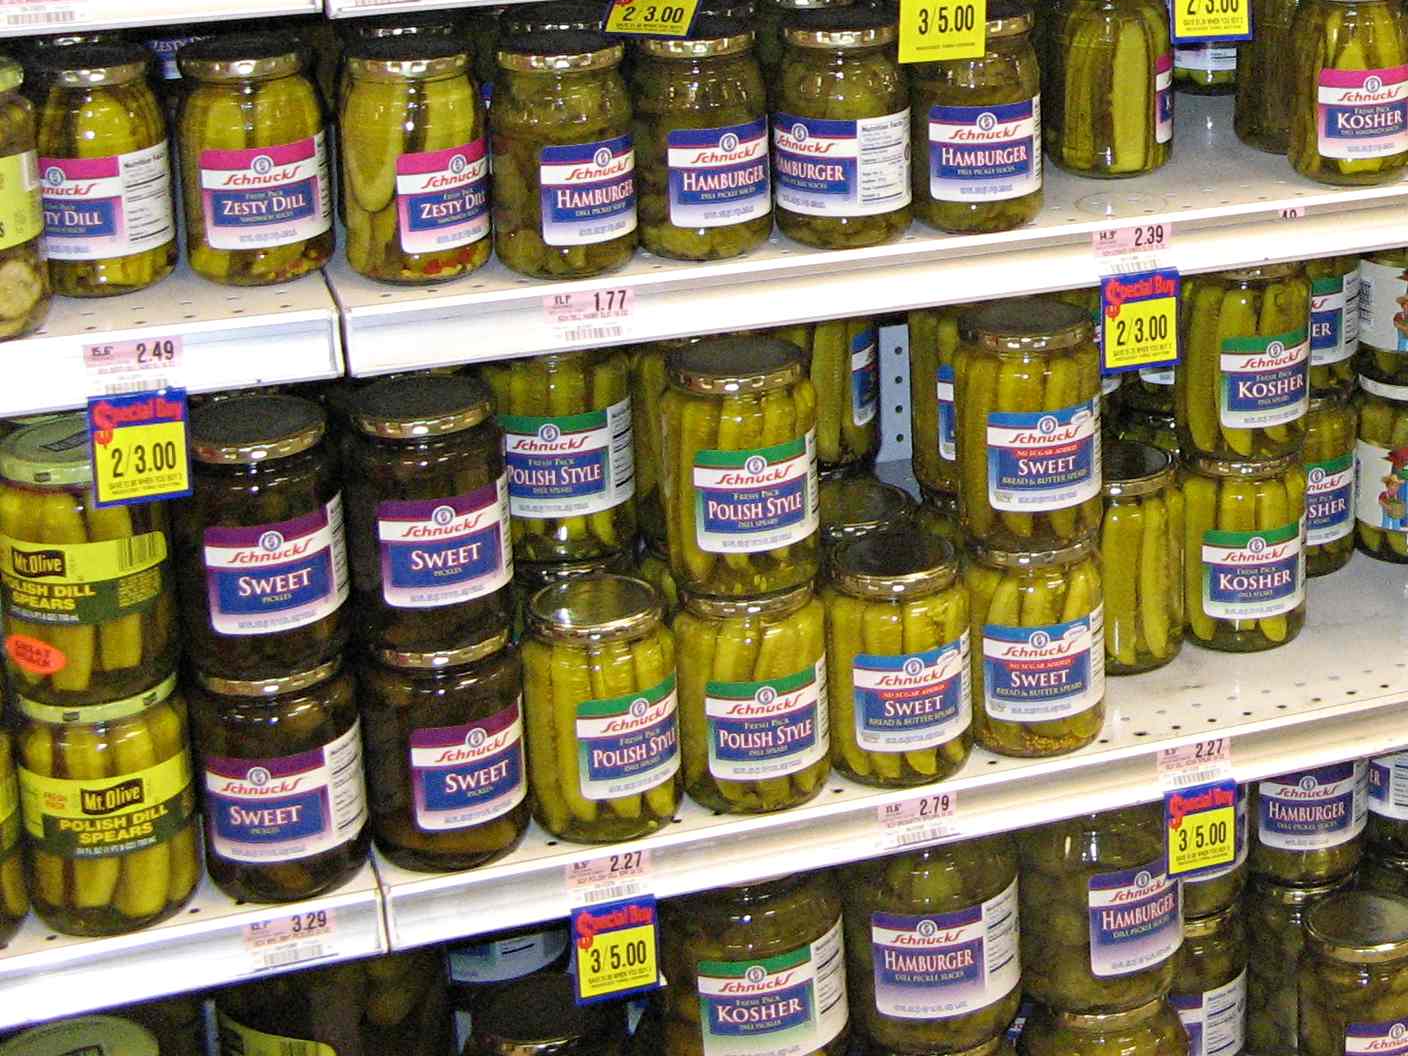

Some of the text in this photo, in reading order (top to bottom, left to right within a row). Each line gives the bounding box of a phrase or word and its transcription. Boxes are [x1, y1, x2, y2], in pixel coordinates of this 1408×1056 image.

[1336, 111, 1402, 130] KOSHER
[941, 146, 1028, 168] HAMBURGER
[682, 167, 765, 192] HAMBURGER
[223, 193, 306, 217] ZESTY DILL
[1134, 225, 1164, 247] 2.39
[594, 290, 627, 311] 1.77
[136, 342, 175, 363] 2.49
[1238, 374, 1304, 397] KOSHER
[506, 463, 600, 487] POLISH STYLE
[1019, 456, 1075, 475] SWEET
[708, 493, 802, 520] POLISH STYLE
[412, 544, 481, 570] SWEET
[239, 568, 312, 596] SWEET
[1219, 569, 1291, 592] KOSHER
[885, 696, 943, 716] SWEET
[920, 796, 950, 816] 2.79
[1268, 801, 1345, 821] HAMBURGER
[59, 805, 168, 834] POLISH DILL
[80, 821, 154, 844] SPEARS
[610, 851, 643, 873] 2.27
[292, 911, 328, 933] 3.29
[883, 949, 974, 972] HAMBURGER
[717, 999, 803, 1023] KOSHER
